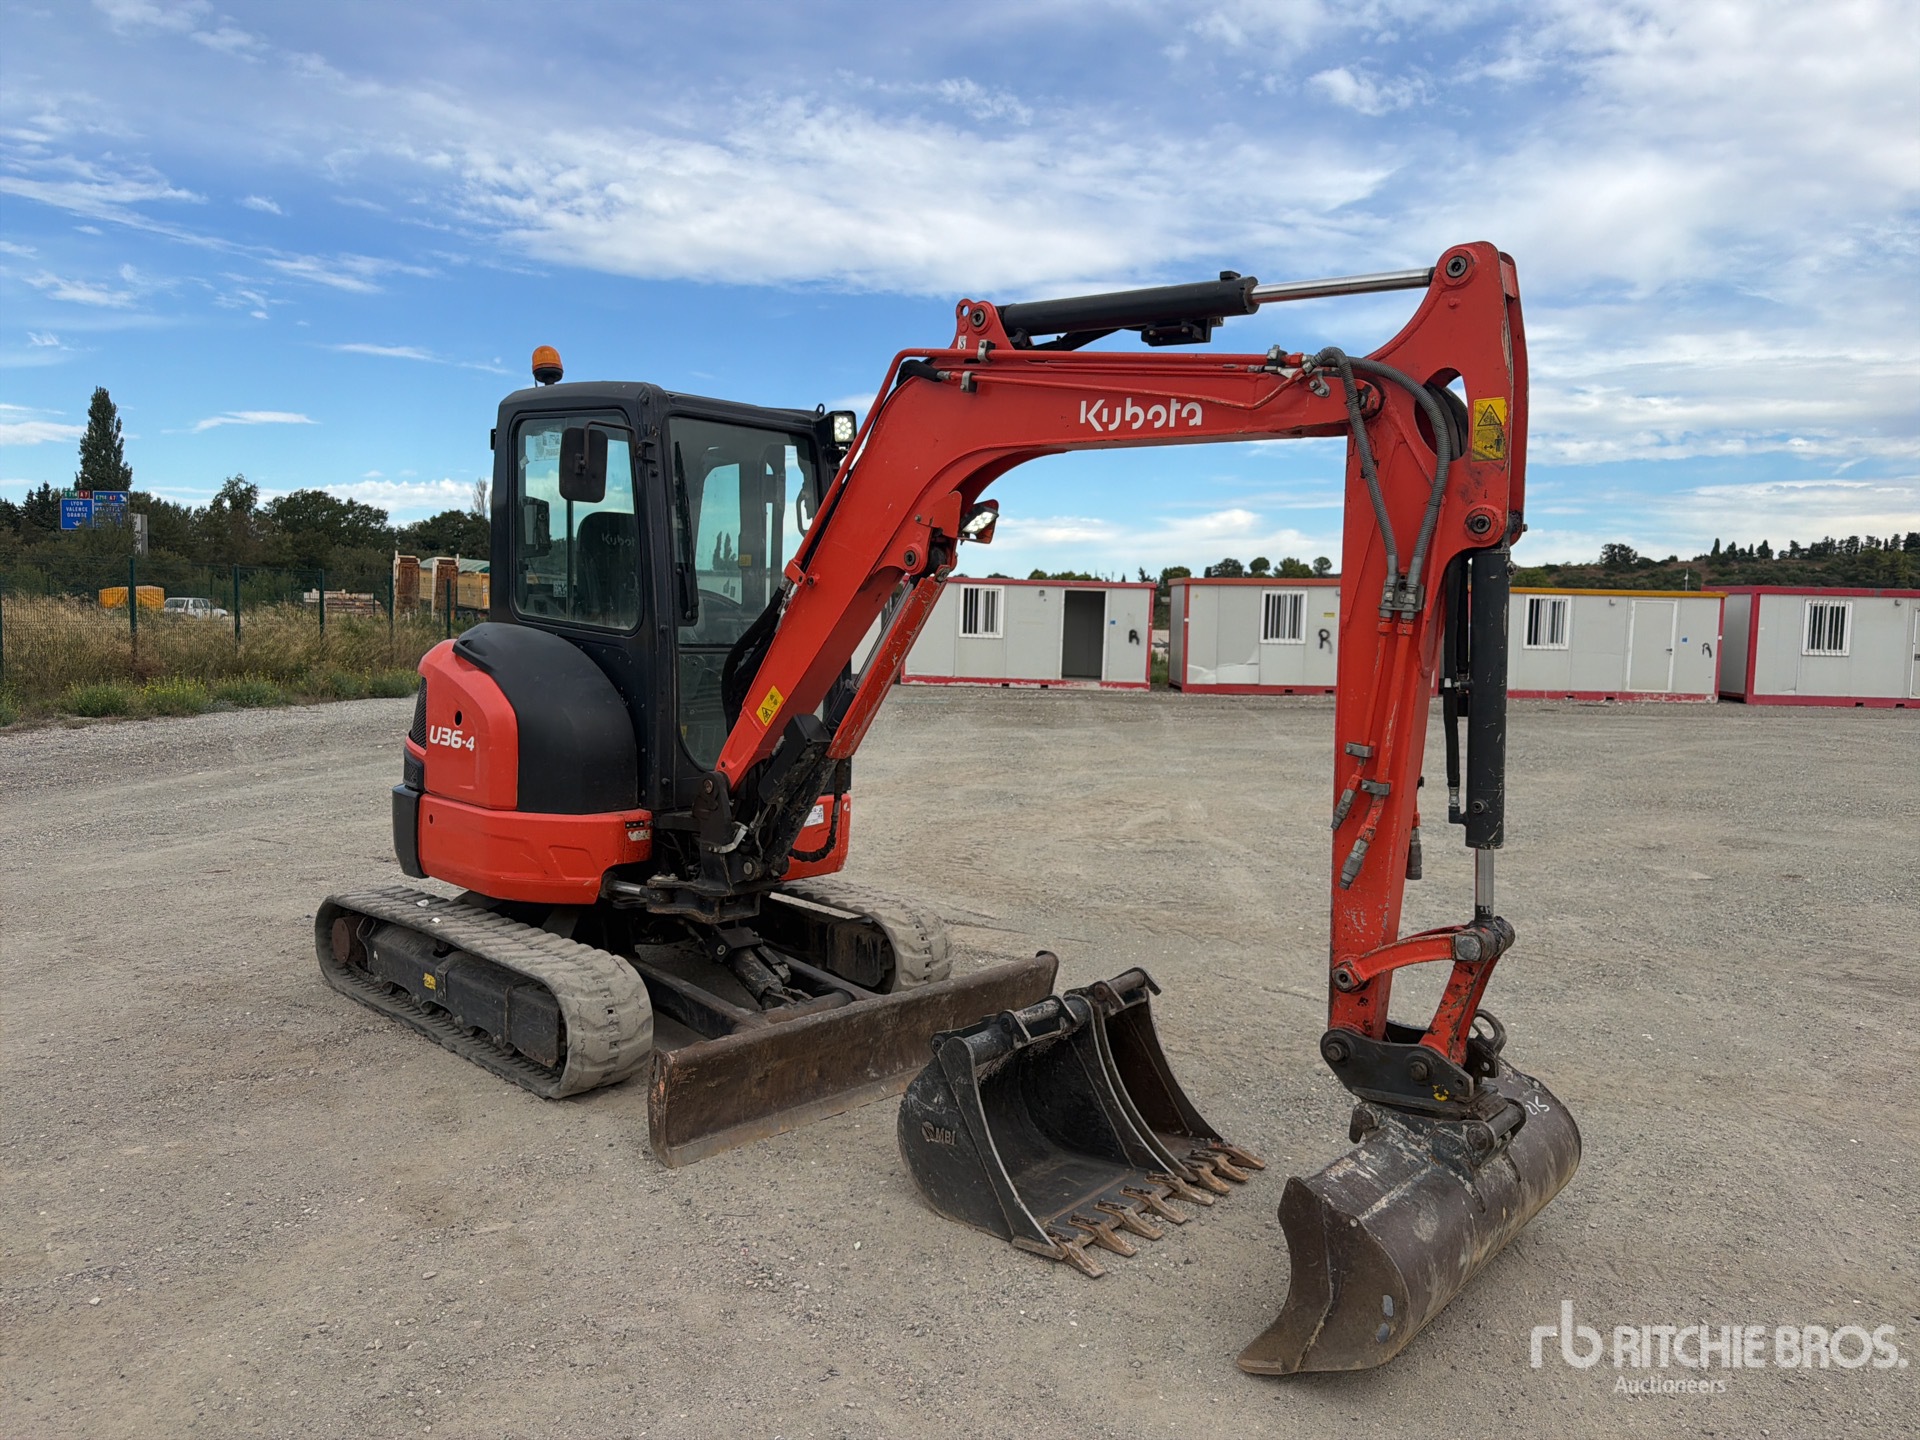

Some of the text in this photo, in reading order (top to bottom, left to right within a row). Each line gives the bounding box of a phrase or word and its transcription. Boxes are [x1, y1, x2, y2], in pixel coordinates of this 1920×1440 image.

[1079, 397, 1202, 432] Kubota
[601, 532, 636, 547] Kubot
[1128, 629, 1140, 645] R
[1318, 628, 1333, 654] R
[429, 725, 475, 752] U36-4
